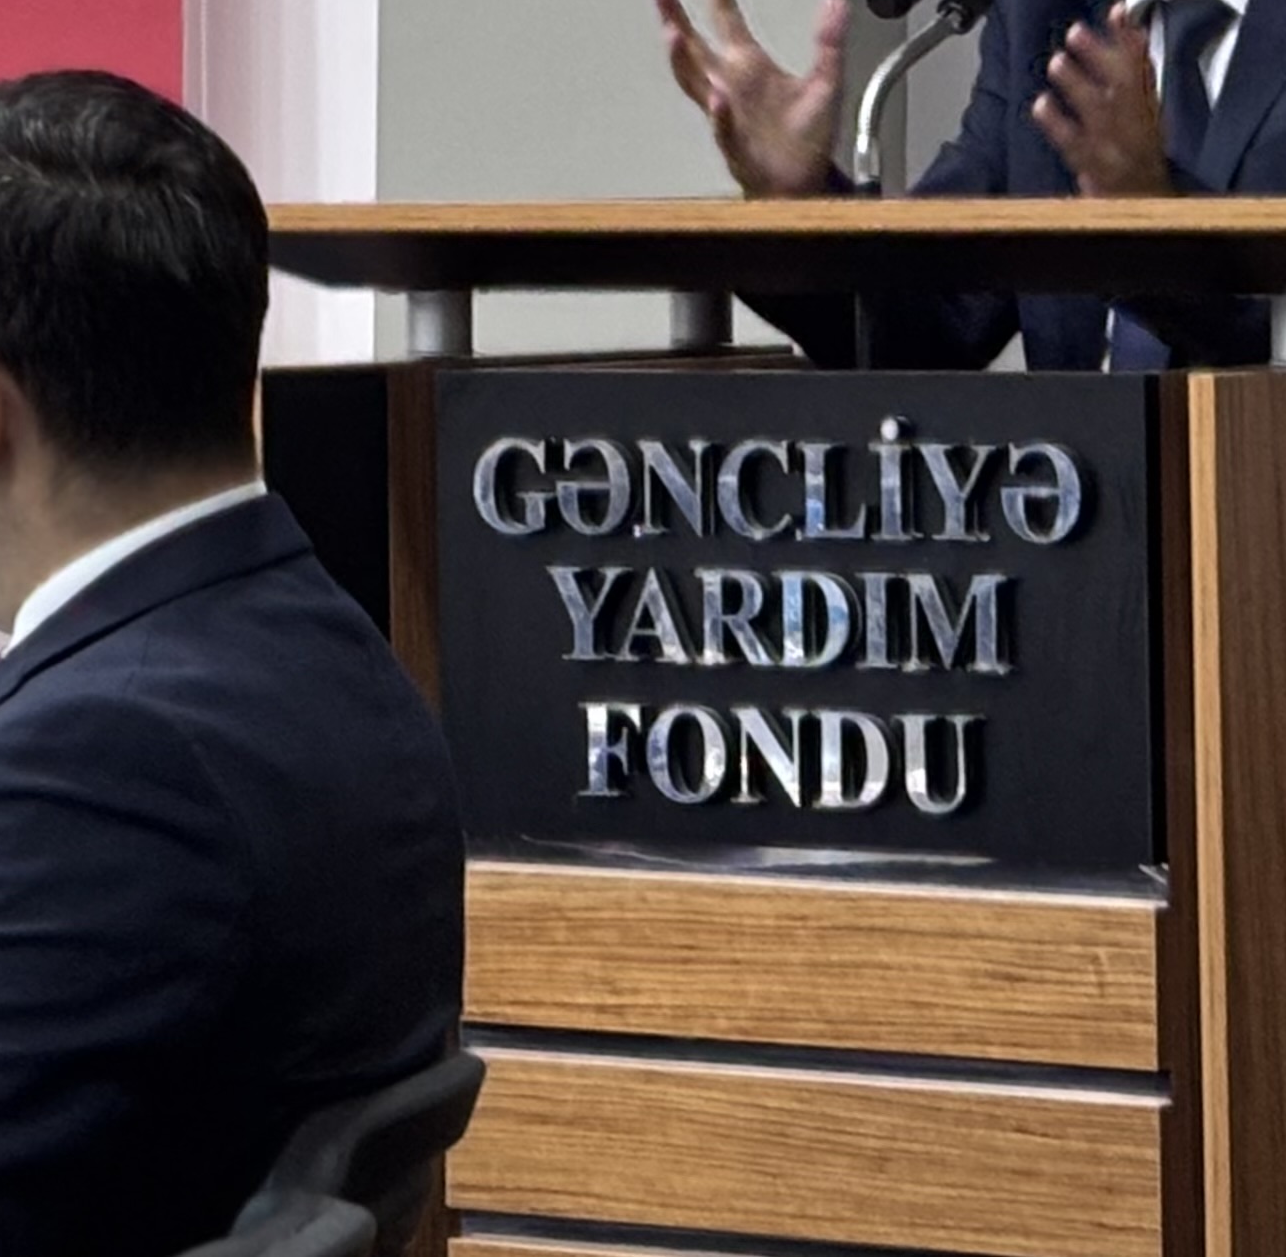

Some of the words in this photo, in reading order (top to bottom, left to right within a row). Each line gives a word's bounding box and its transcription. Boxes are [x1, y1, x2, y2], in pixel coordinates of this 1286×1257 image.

[472, 415, 1087, 545] GƏNCLİYƏ
[545, 565, 1018, 675] YARDIM
[574, 701, 985, 816] FONDU
